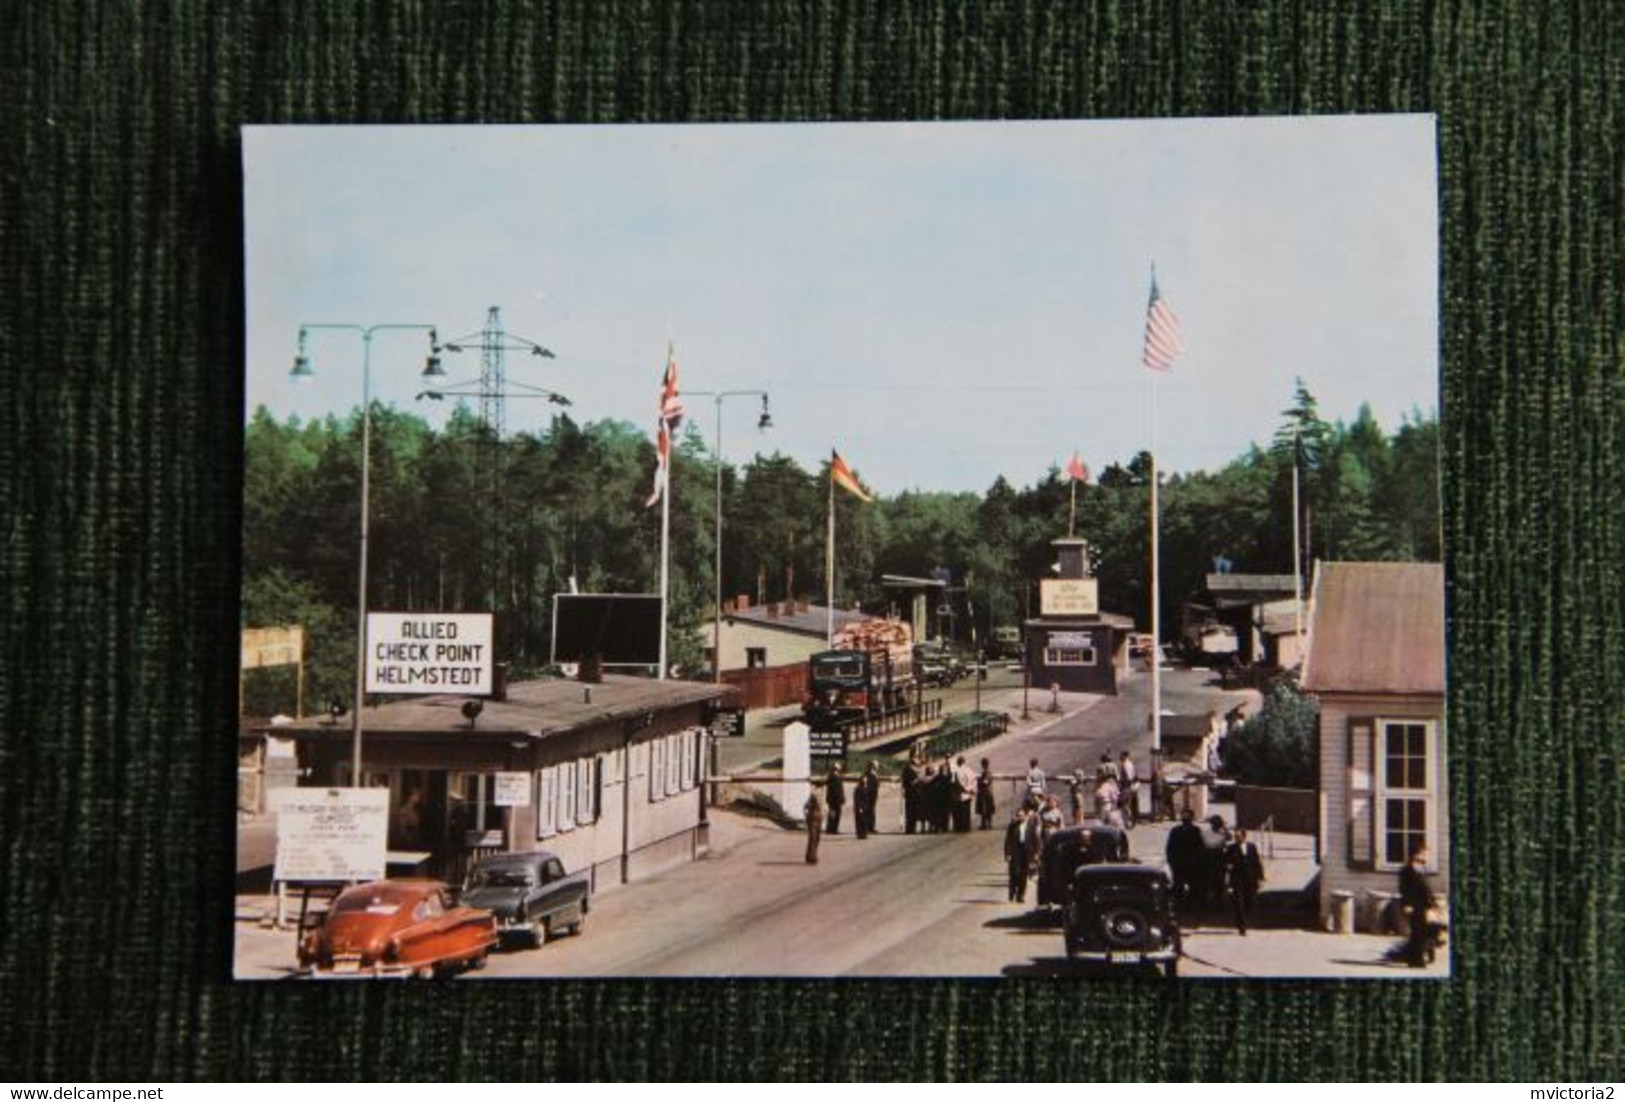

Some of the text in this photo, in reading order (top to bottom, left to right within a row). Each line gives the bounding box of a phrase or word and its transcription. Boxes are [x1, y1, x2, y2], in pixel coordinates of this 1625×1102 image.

[401, 621, 457, 640] ALLIED
[376, 642, 483, 662] CHECK POINT
[376, 665, 482, 685] HELMSTEDT
